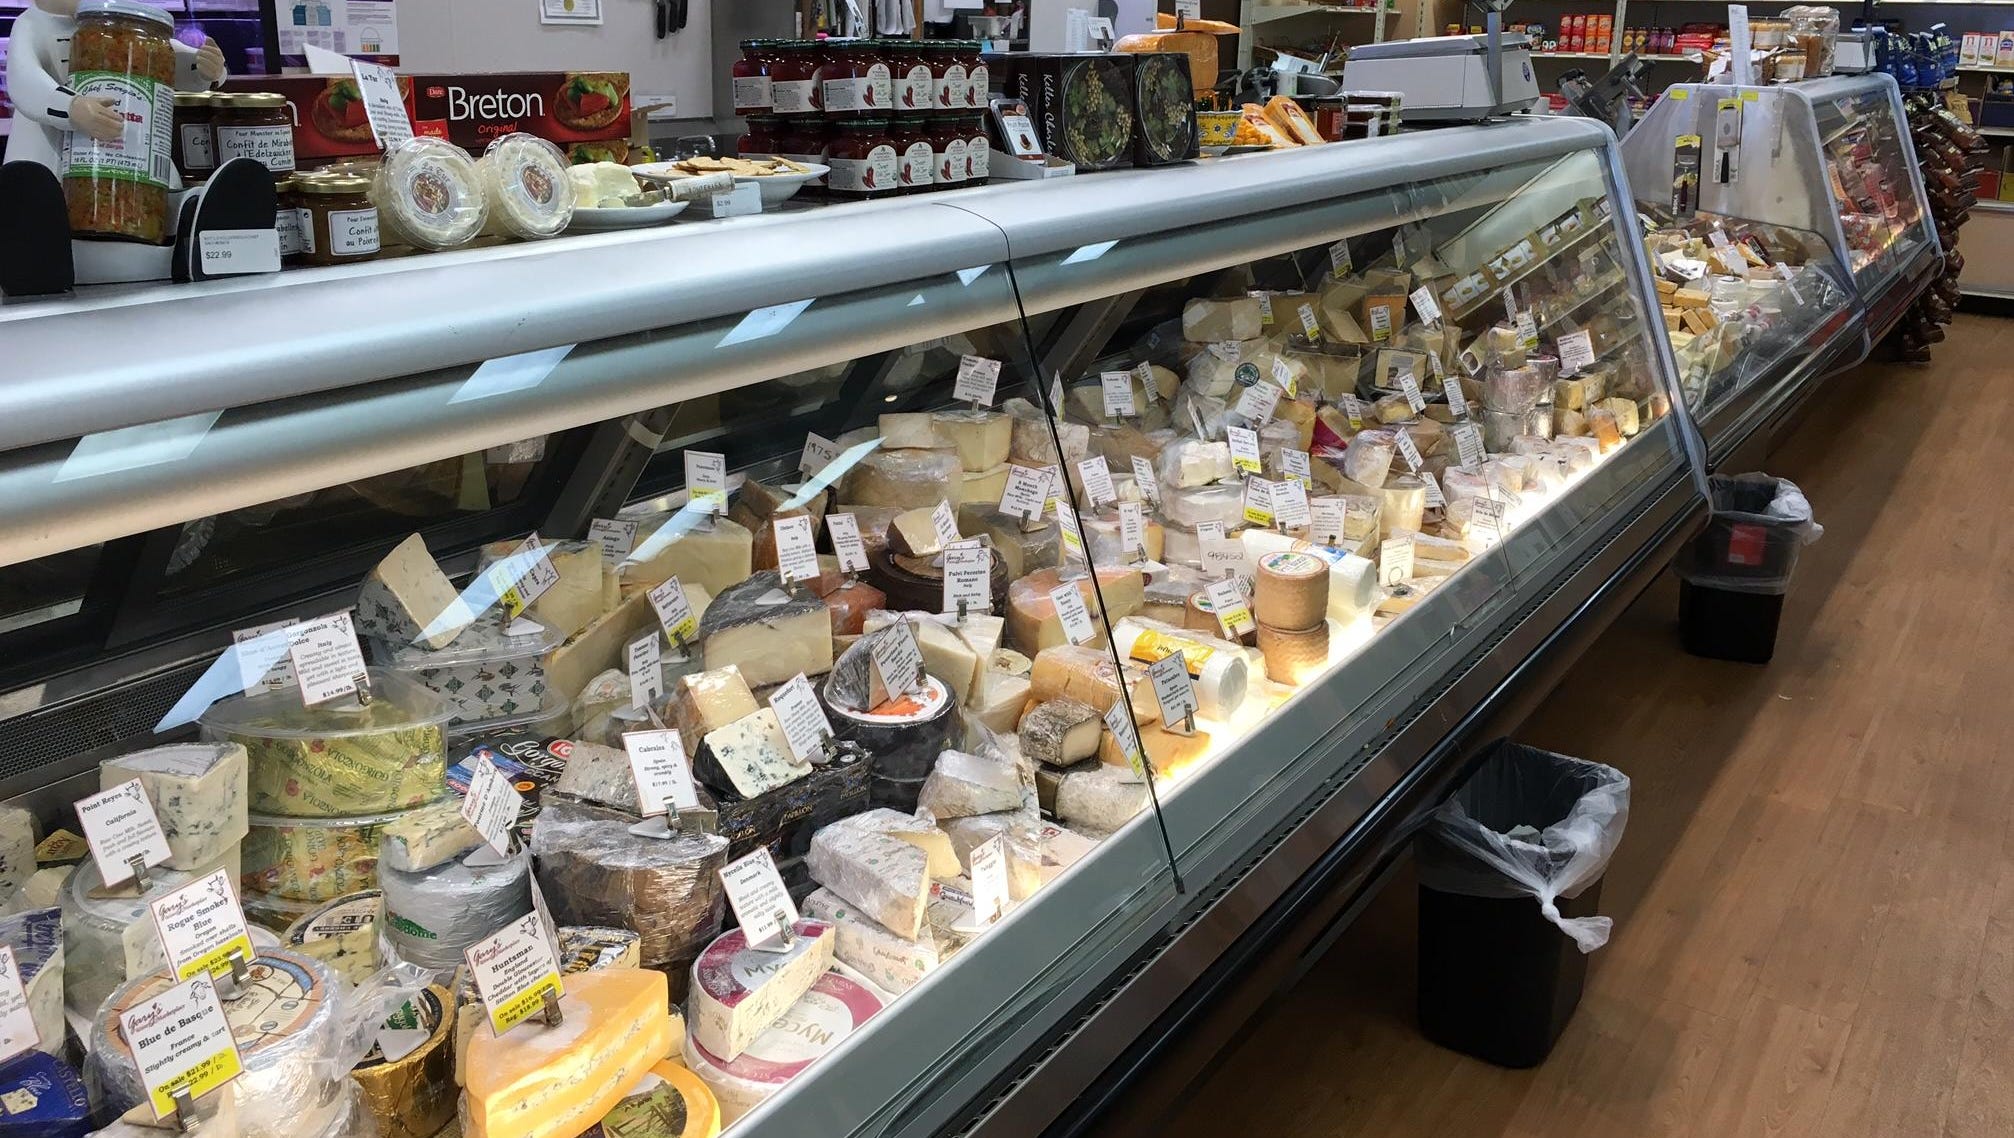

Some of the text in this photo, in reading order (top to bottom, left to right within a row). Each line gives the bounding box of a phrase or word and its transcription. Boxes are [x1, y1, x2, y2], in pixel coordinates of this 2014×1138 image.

[447, 86, 544, 121] Breton
[477, 121, 518, 138] Original
[226, 138, 255, 149] Confit
[257, 139, 269, 149] de
[348, 227, 372, 237] Confit
[205, 250, 233, 259] $22.99
[82, 792, 122, 813] Point Reyes
[105, 808, 137, 826] California
[167, 896, 229, 932] Rogue Smokey
[193, 917, 213, 932] Blue
[195, 925, 217, 940] Oregon
[192, 943, 215, 958] Oregon
[490, 944, 534, 973] Huntsman
[186, 962, 209, 978] On sale
[503, 956, 528, 975] England
[487, 983, 514, 1002] Cheddar
[513, 975, 527, 986] with
[492, 975, 513, 991] Double
[127, 1001, 163, 1034] Gary's
[498, 1011, 509, 1019] On
[509, 1004, 521, 1014] sale
[137, 1004, 214, 1050] Blue de Basque
[169, 1033, 196, 1051] France
[144, 1055, 175, 1075] Slightly
[175, 1040, 202, 1059] creamy
[158, 1084, 170, 1093] On
[170, 1074, 186, 1087] sale
[186, 1059, 212, 1078] $21.99
